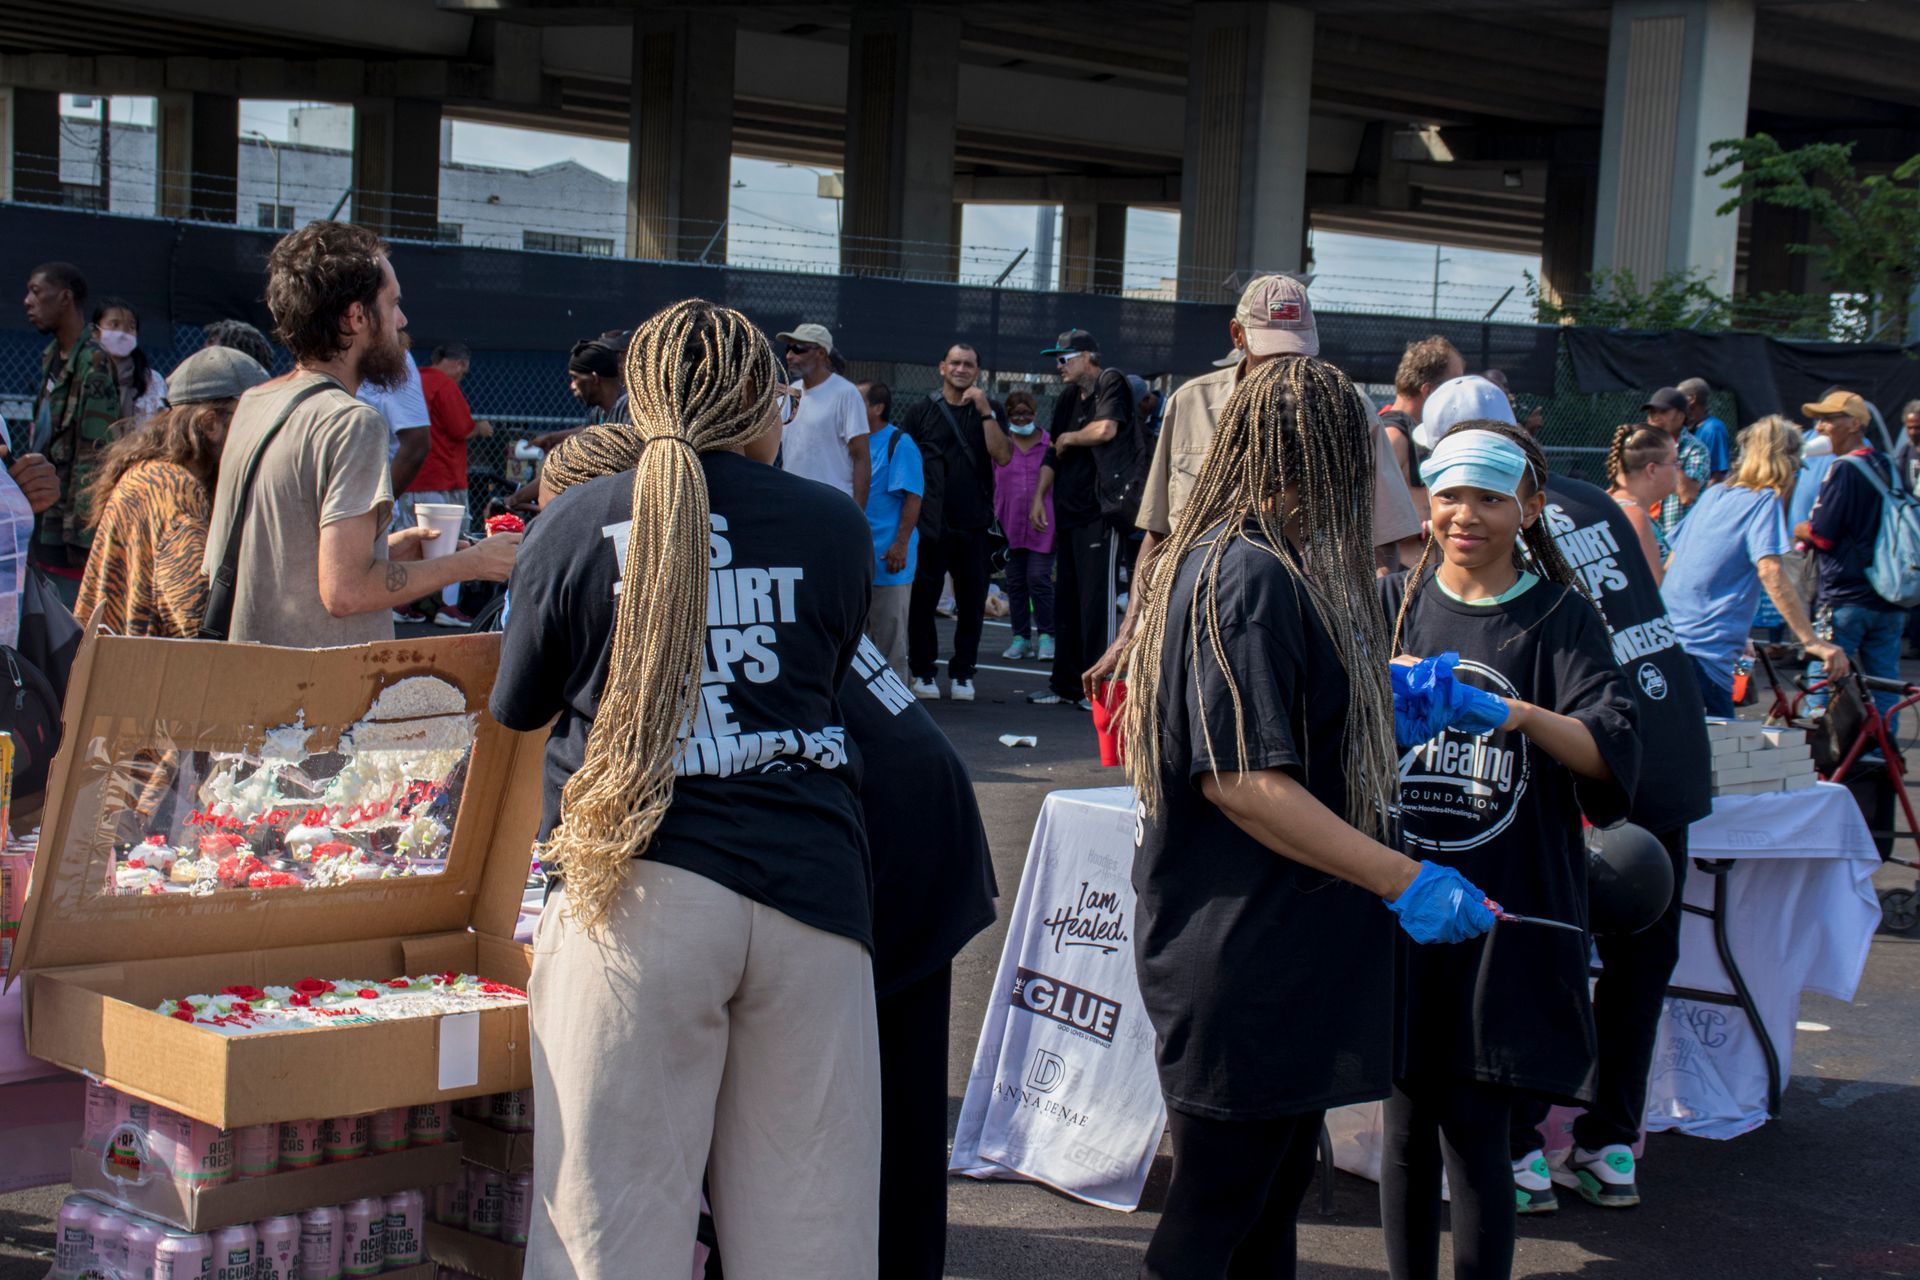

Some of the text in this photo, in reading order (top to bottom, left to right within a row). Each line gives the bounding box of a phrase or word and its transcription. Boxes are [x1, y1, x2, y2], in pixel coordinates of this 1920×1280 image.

[1425, 730, 1515, 793] Healing
[1402, 789, 1499, 811] FOUNDATION
[1076, 881, 1121, 916] I am
[1043, 906, 1129, 954] Healed.
[1012, 977, 1026, 995] THE
[1023, 978, 1117, 1038] G.L.U.E.
[993, 1082, 1041, 1108] ANNA
[1044, 1100, 1089, 1128] DENAE
[384, 1240, 418, 1255] ESCAS
